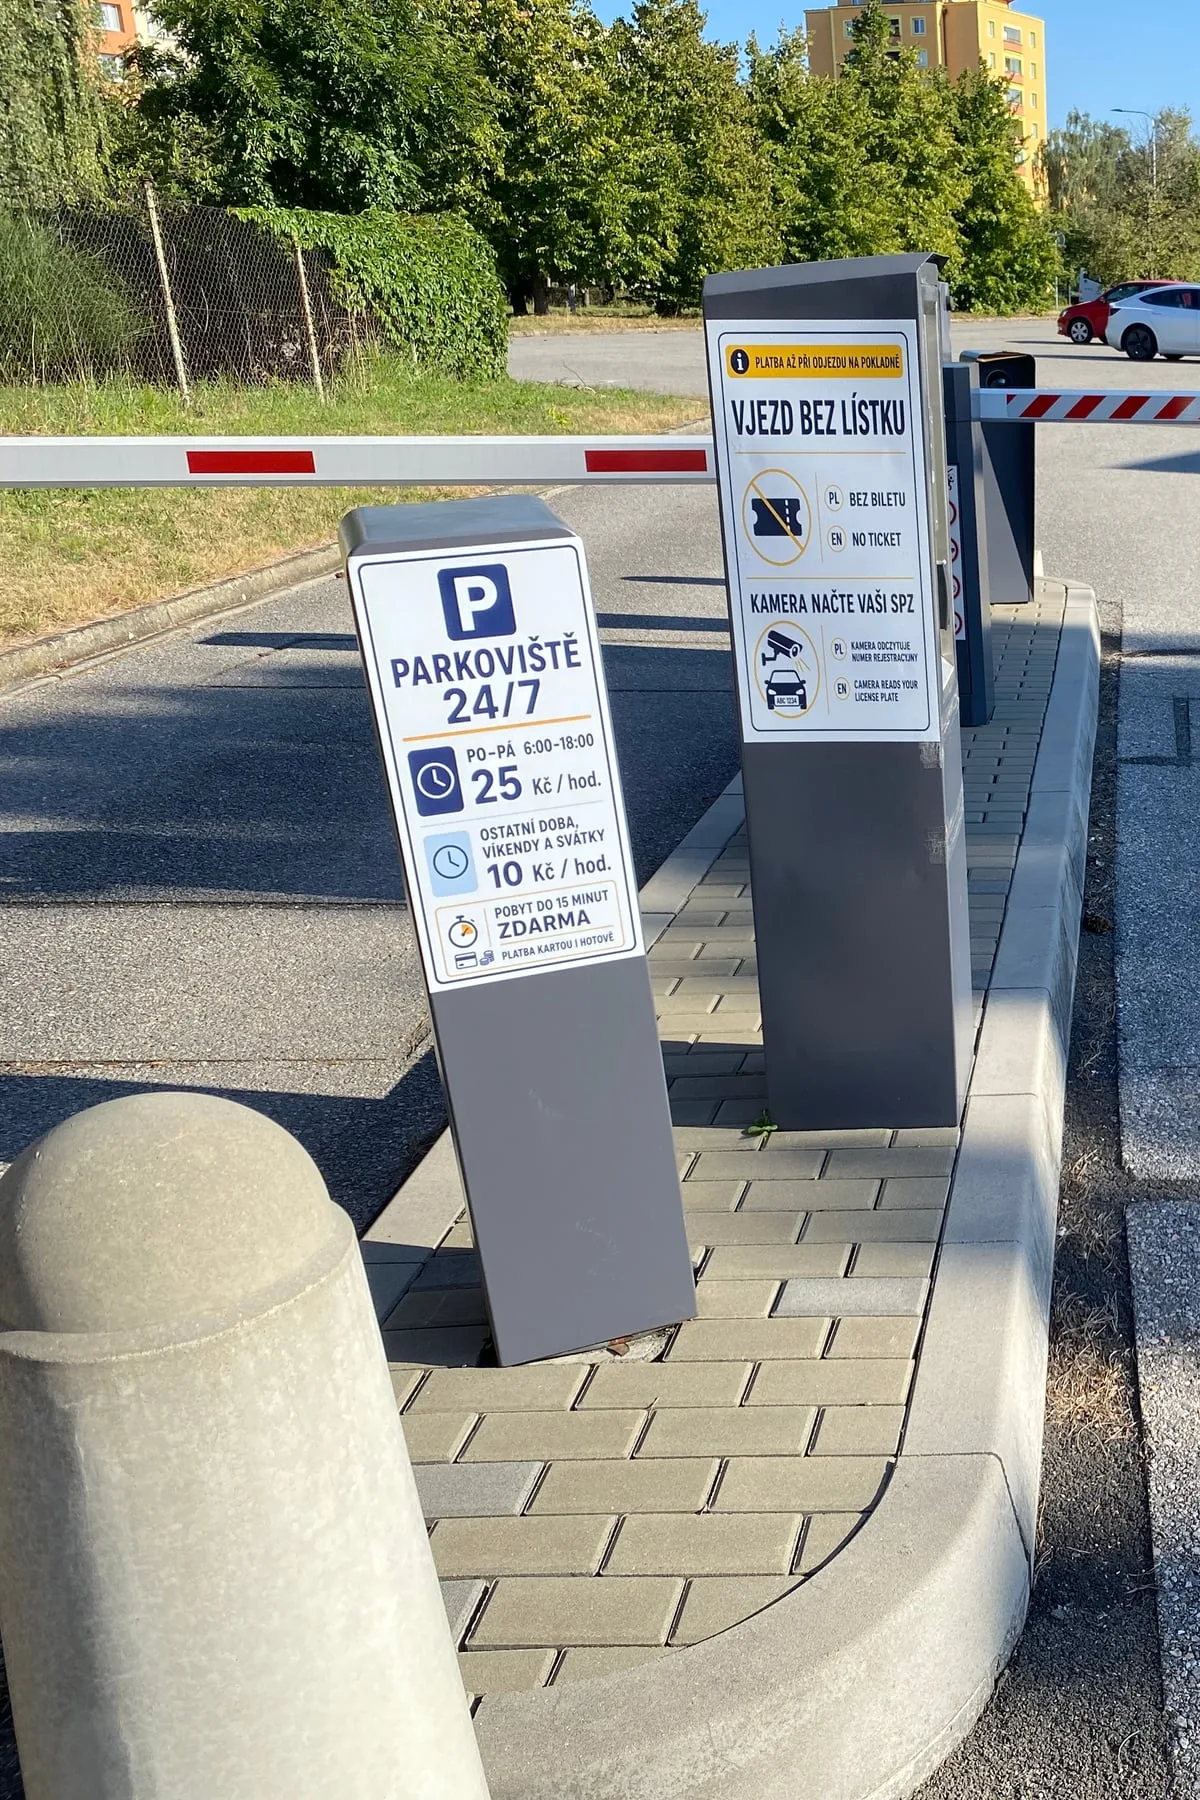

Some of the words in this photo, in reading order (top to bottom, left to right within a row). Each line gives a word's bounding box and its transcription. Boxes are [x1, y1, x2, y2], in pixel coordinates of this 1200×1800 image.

[756, 356, 784, 368] PLATBA
[787, 354, 796, 368] AŽ
[798, 354, 810, 368] PŘI
[812, 356, 846, 368] ODJEZDU
[849, 356, 859, 368] NA
[861, 354, 900, 368] POKLADNĚ
[731, 400, 793, 435] VJEZD
[800, 400, 836, 435] BEZ
[842, 392, 905, 435] LÍSTKU
[829, 492, 839, 504] PL
[850, 492, 868, 506] BEZ
[871, 492, 905, 506] BILETU
[832, 533, 842, 545] EN
[852, 533, 866, 546] NO
[868, 533, 901, 546] TICKET
[454, 575, 497, 632] P
[751, 594, 807, 614] KAMERA
[812, 590, 854, 614] NAČTE
[857, 589, 887, 614] VAŠI
[891, 593, 914, 614] SPZ
[835, 644, 844, 655] PL
[851, 642, 876, 650] KAMERA
[877, 642, 911, 650] ODCZYTUJE
[852, 654, 872, 662] NUMER
[390, 632, 581, 687] PARKOVIŠTĚ
[838, 683, 846, 694] EN
[854, 680, 880, 689] CAMERA
[881, 680, 901, 689] READS
[902, 680, 918, 689] YOUR
[855, 693, 879, 701] LICENSE
[881, 693, 899, 701] PLATE
[443, 679, 540, 725] 24/7
[523, 733, 594, 755] 6:00-18:00
[471, 765, 522, 804] 25
[532, 778, 552, 795] Kč
[568, 771, 601, 789] hod.
[480, 818, 536, 841] OSTATNÍ
[539, 816, 579, 832] DOBA,
[482, 838, 539, 859] VÍKENDY
[544, 836, 554, 850] A
[557, 829, 605, 848] SVÁTKY
[487, 861, 523, 888] 10
[532, 864, 555, 882] Kč
[574, 855, 611, 875] hod.
[494, 902, 534, 919] POBYT
[537, 899, 553, 912] DO
[556, 896, 569, 909] 15
[572, 890, 609, 906] MINUT
[497, 909, 591, 940] ZDARMA
[502, 945, 535, 961] PLATBA
[538, 941, 572, 955] KARTOU
[575, 939, 578, 948] I
[580, 932, 614, 947] HOTOVĚ
